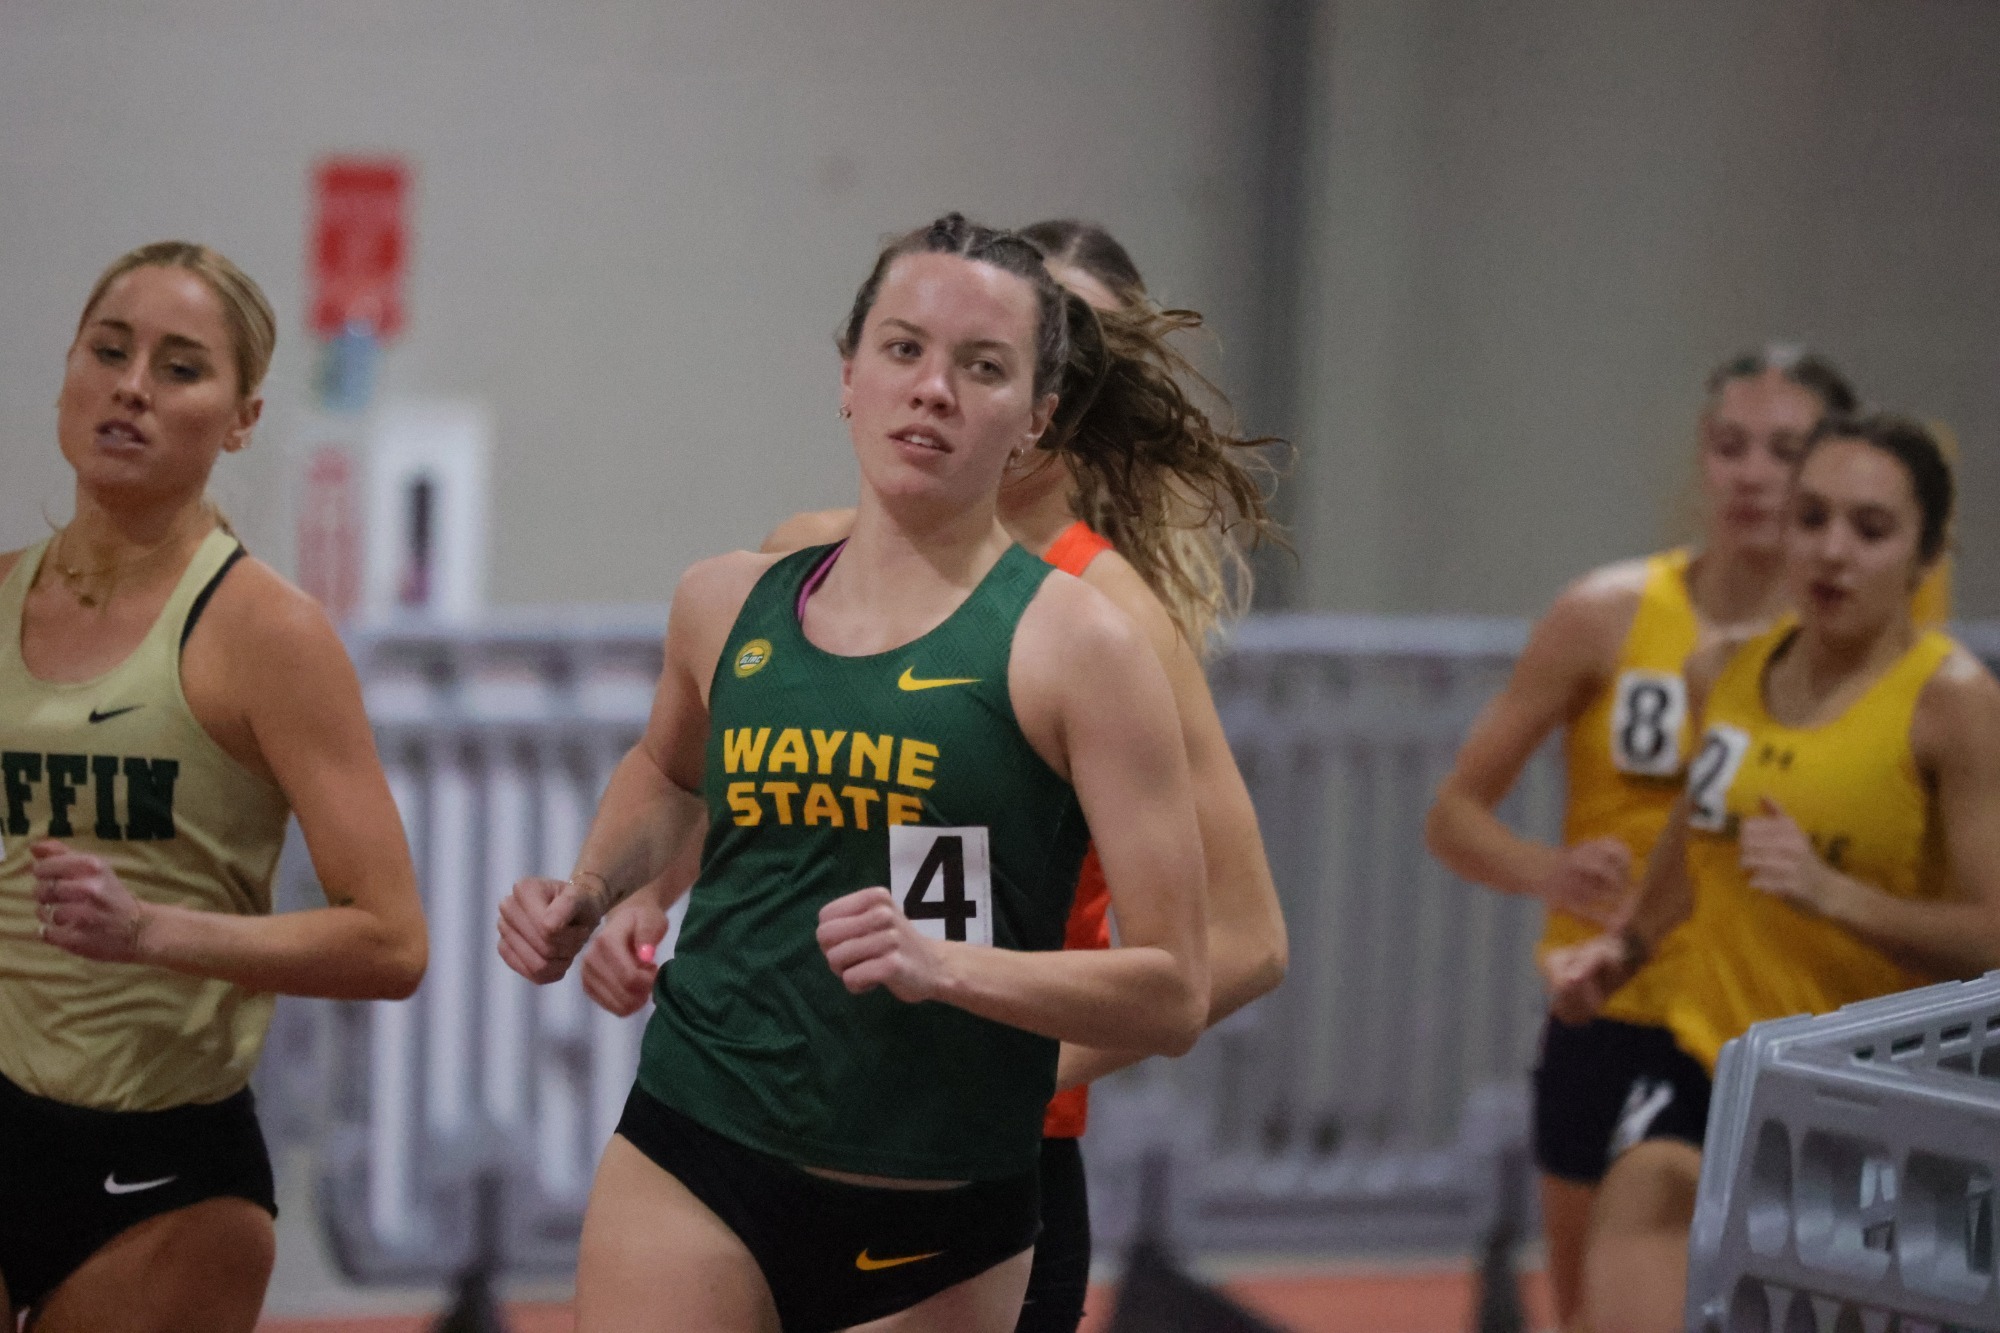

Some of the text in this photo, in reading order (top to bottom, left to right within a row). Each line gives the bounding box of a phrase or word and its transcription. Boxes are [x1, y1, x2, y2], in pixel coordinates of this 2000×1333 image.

[723, 727, 940, 791] WAYNE
[1621, 680, 1669, 764] 8
[0, 752, 179, 840] FFIN
[727, 781, 923, 831] STATE
[1690, 730, 1730, 819] 2
[904, 835, 977, 942] 4
